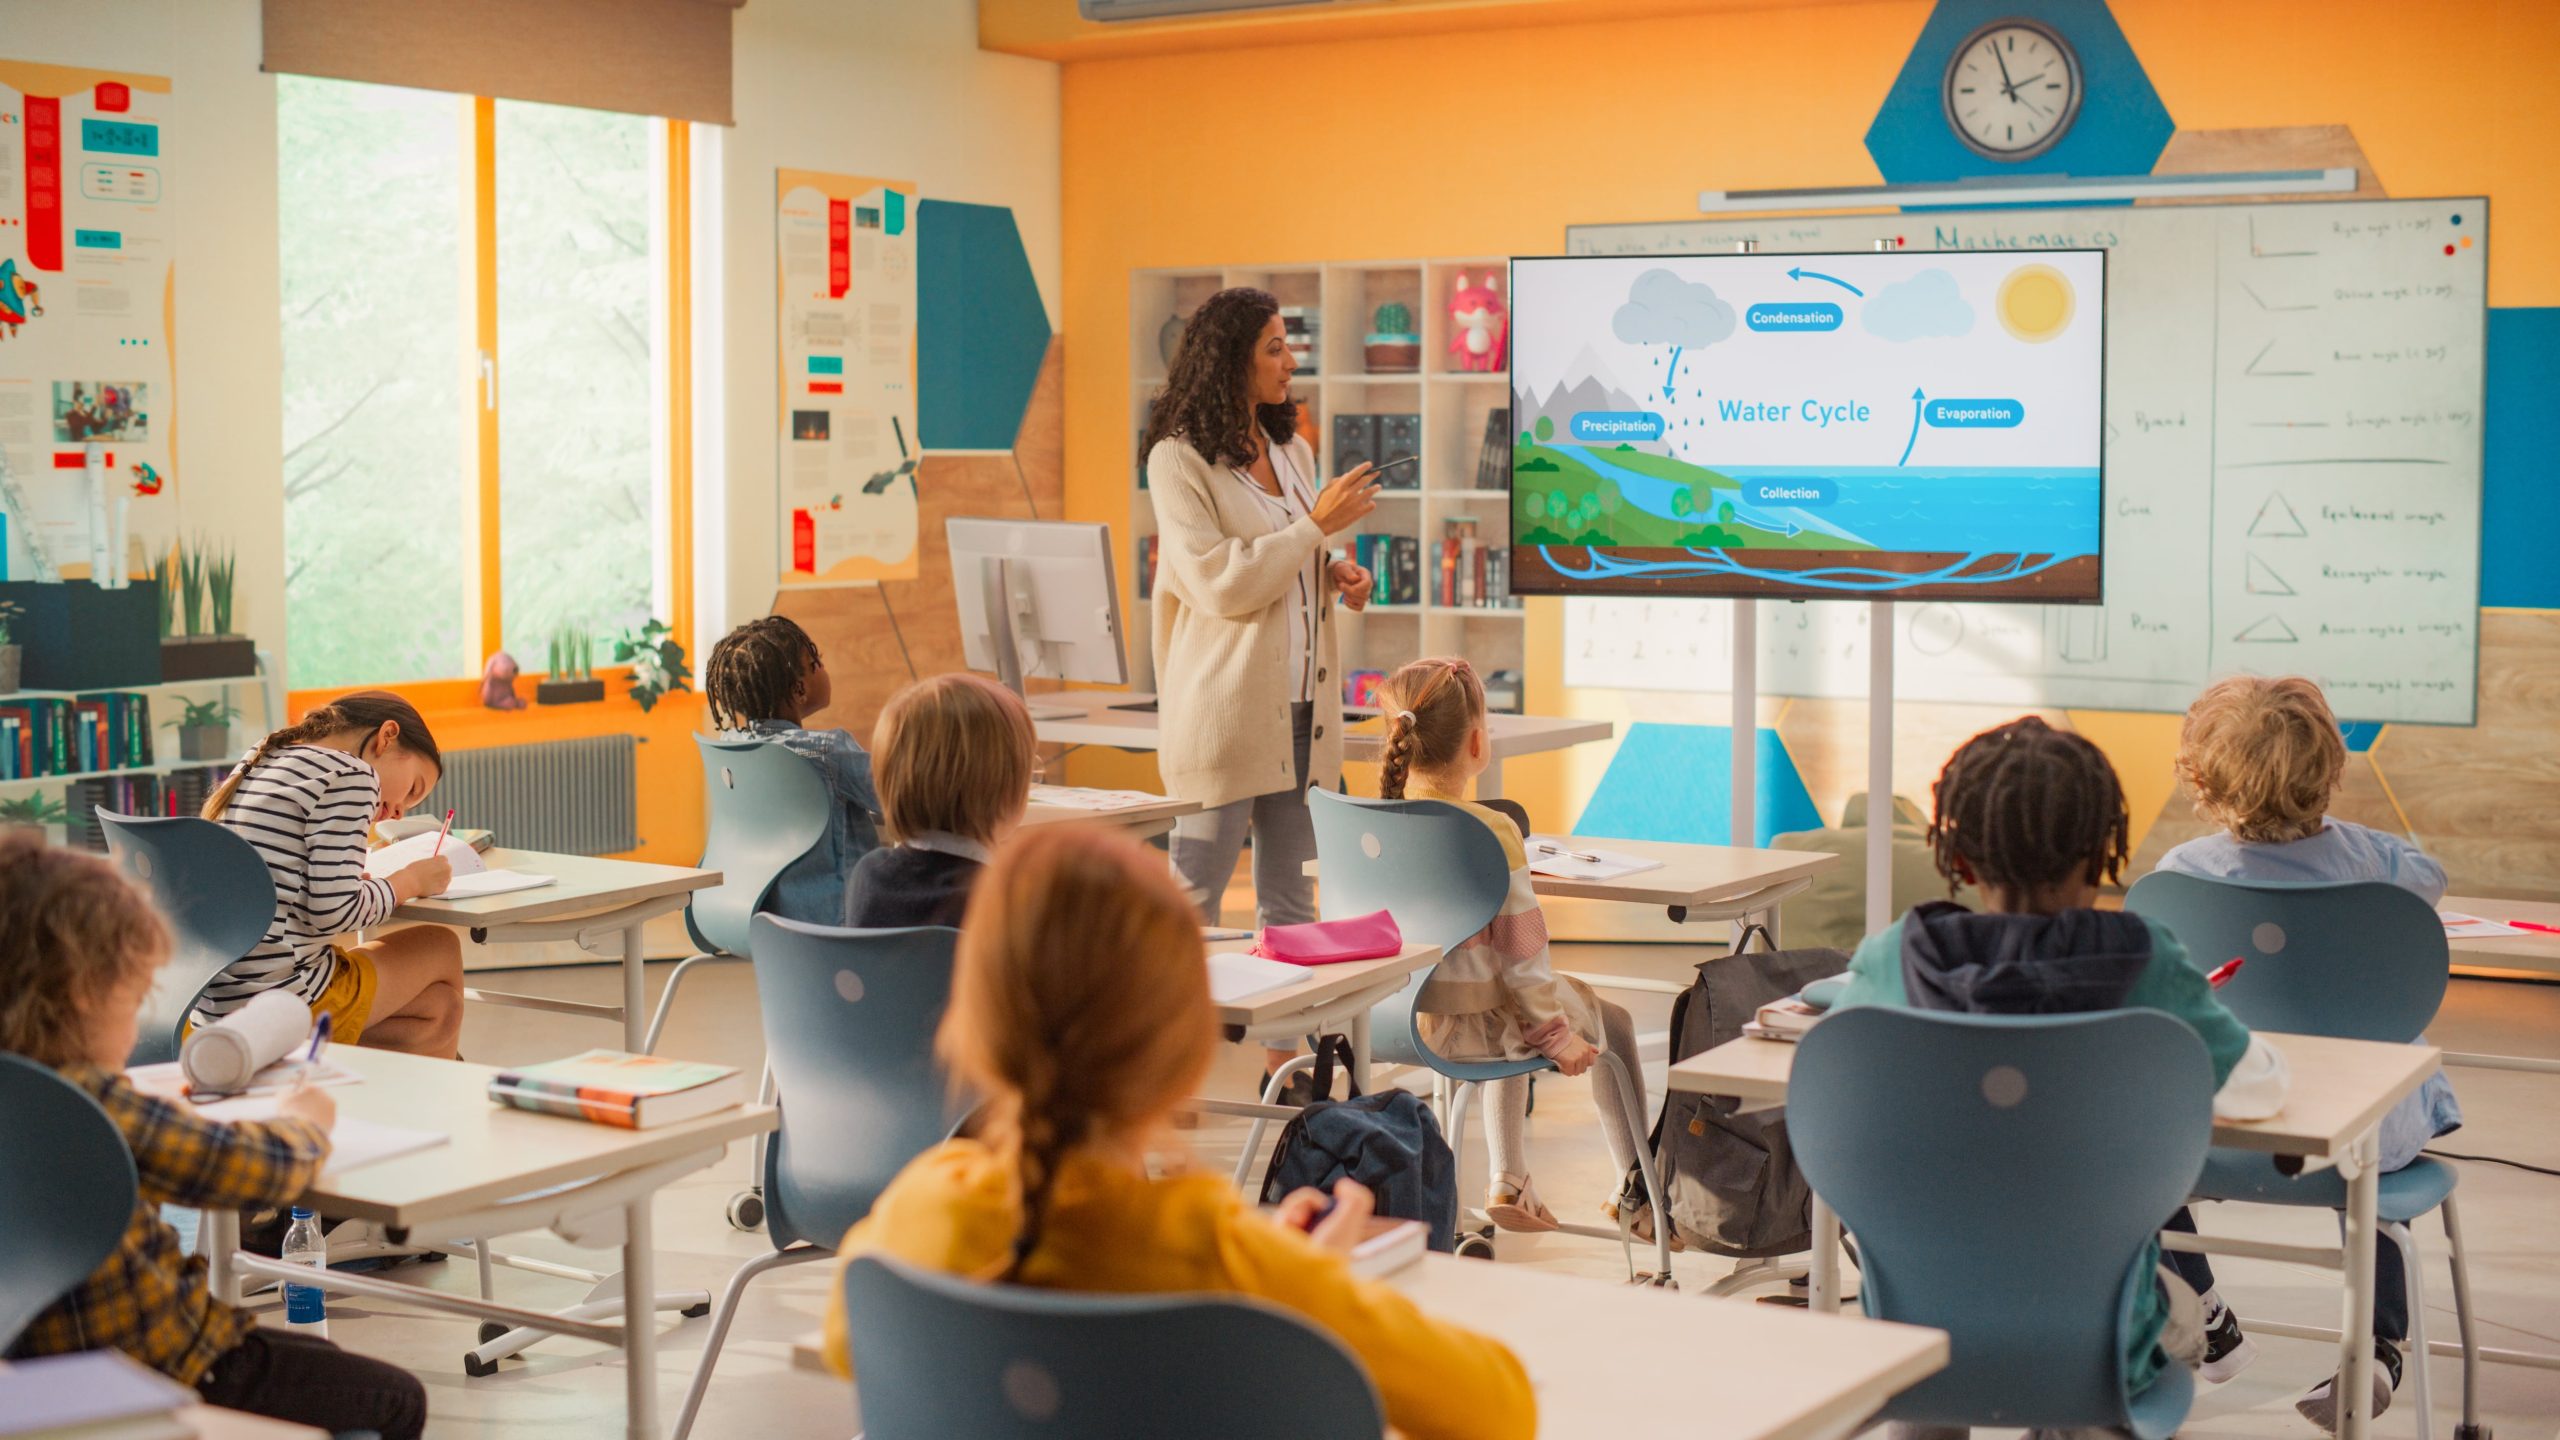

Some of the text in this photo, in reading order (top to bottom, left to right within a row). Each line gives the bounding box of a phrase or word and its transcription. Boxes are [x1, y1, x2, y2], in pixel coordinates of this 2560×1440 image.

[1935, 225, 2118, 250] Mathematics
[1752, 311, 1834, 325] Condensation
[1718, 399, 1870, 428] Water Cycle
[1937, 406, 2011, 423] Evaporation
[1581, 419, 1657, 434] Precipitation
[1759, 486, 1820, 500] Collection
